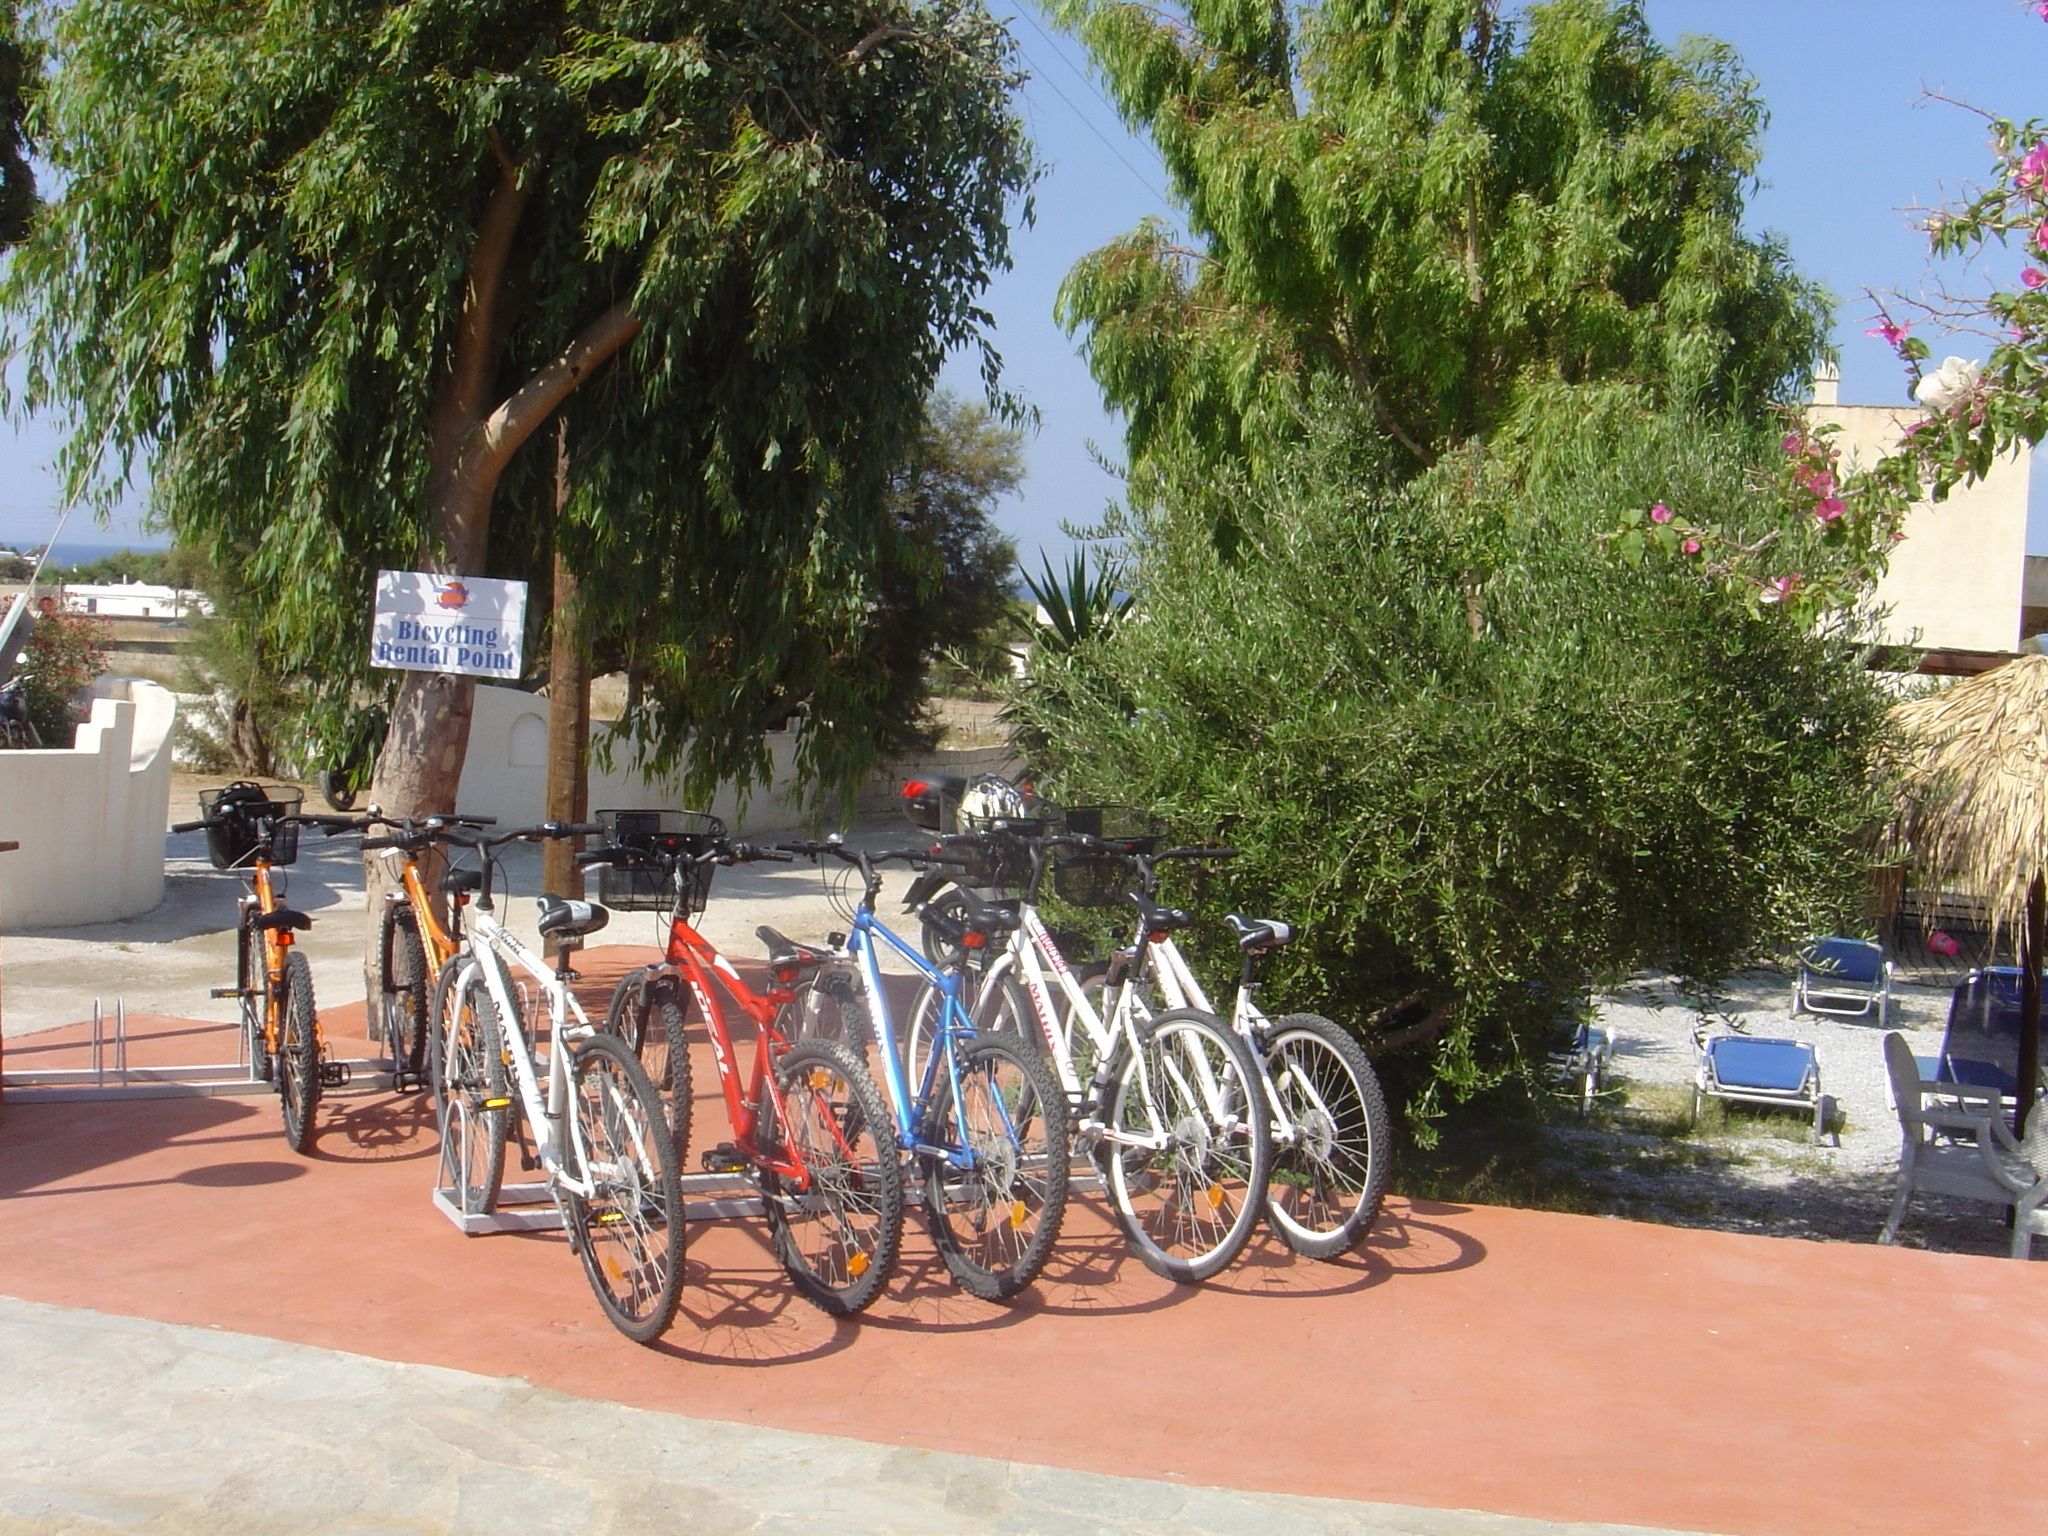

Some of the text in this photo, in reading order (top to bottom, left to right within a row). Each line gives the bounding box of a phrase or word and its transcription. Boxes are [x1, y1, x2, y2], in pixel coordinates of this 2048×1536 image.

[398, 621, 497, 648] Bicycling
[379, 642, 513, 669] Rental Point
